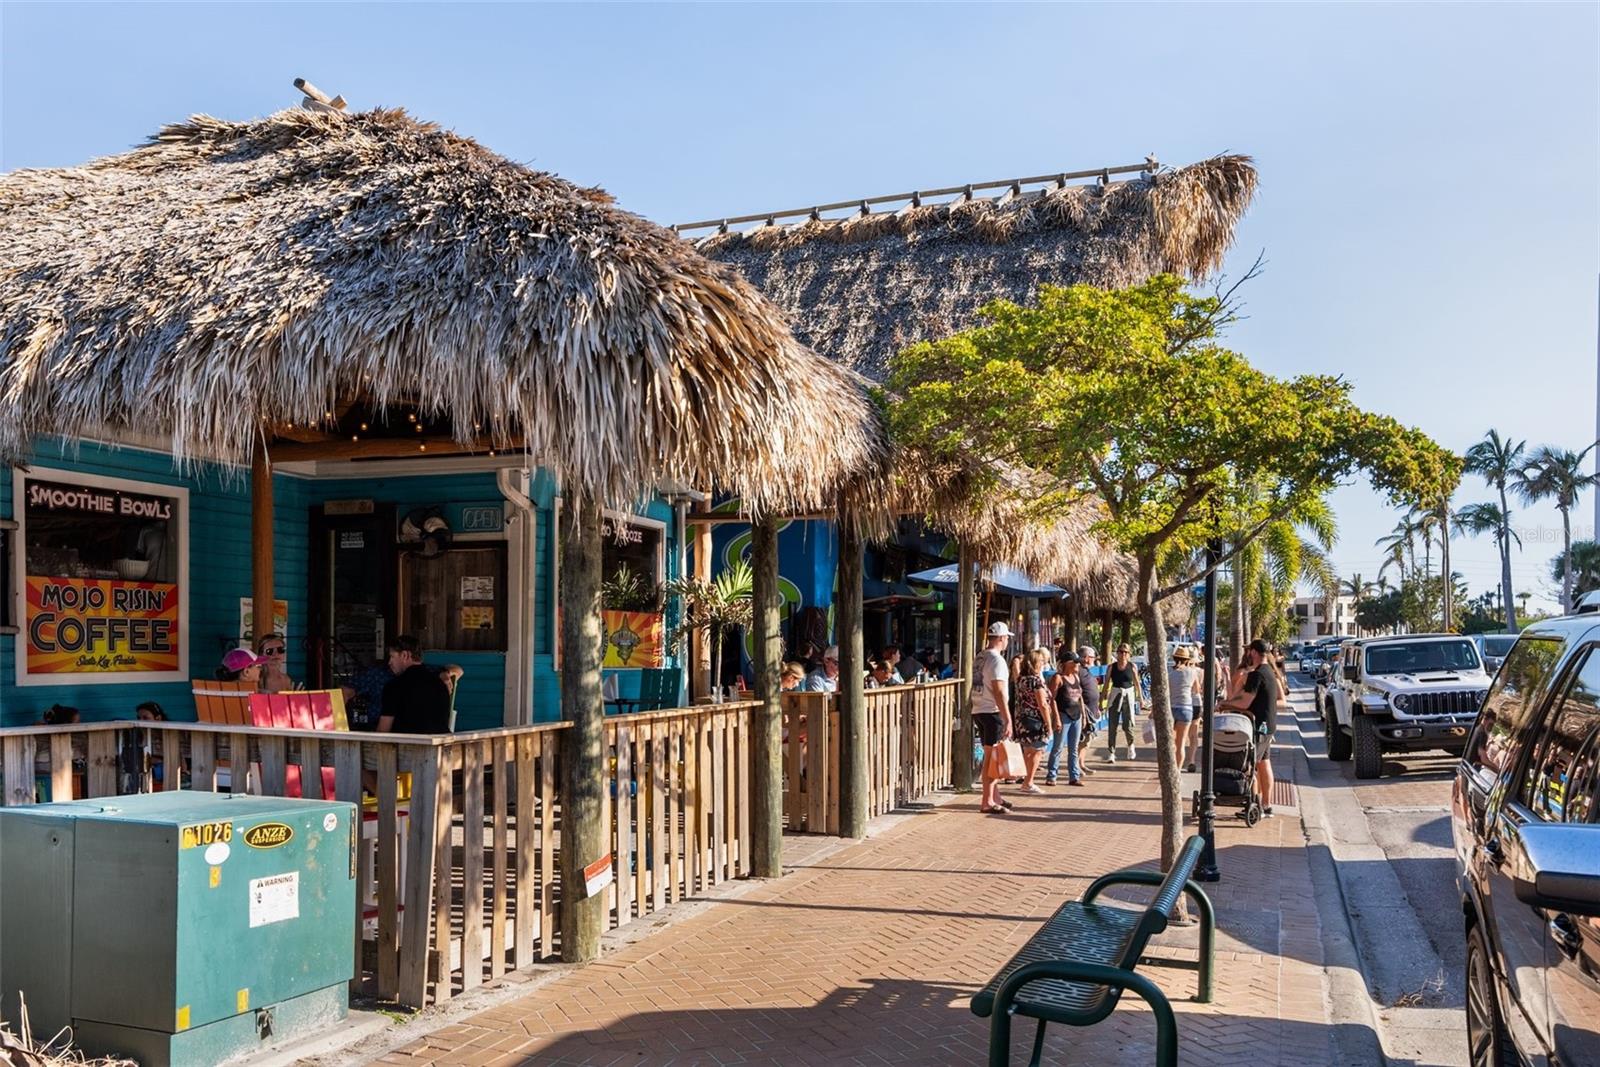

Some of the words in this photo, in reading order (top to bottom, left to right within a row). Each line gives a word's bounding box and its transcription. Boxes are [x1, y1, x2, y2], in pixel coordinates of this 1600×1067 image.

[30, 485, 114, 513] SMOOTHIE
[120, 497, 171, 520] BOWLS
[465, 510, 499, 528] OPEN
[41, 584, 105, 614] MOJO
[112, 587, 168, 614] RISIN'
[29, 611, 172, 653] COFFEE
[252, 826, 287, 840] ANZE
[264, 875, 294, 887] WARNING
